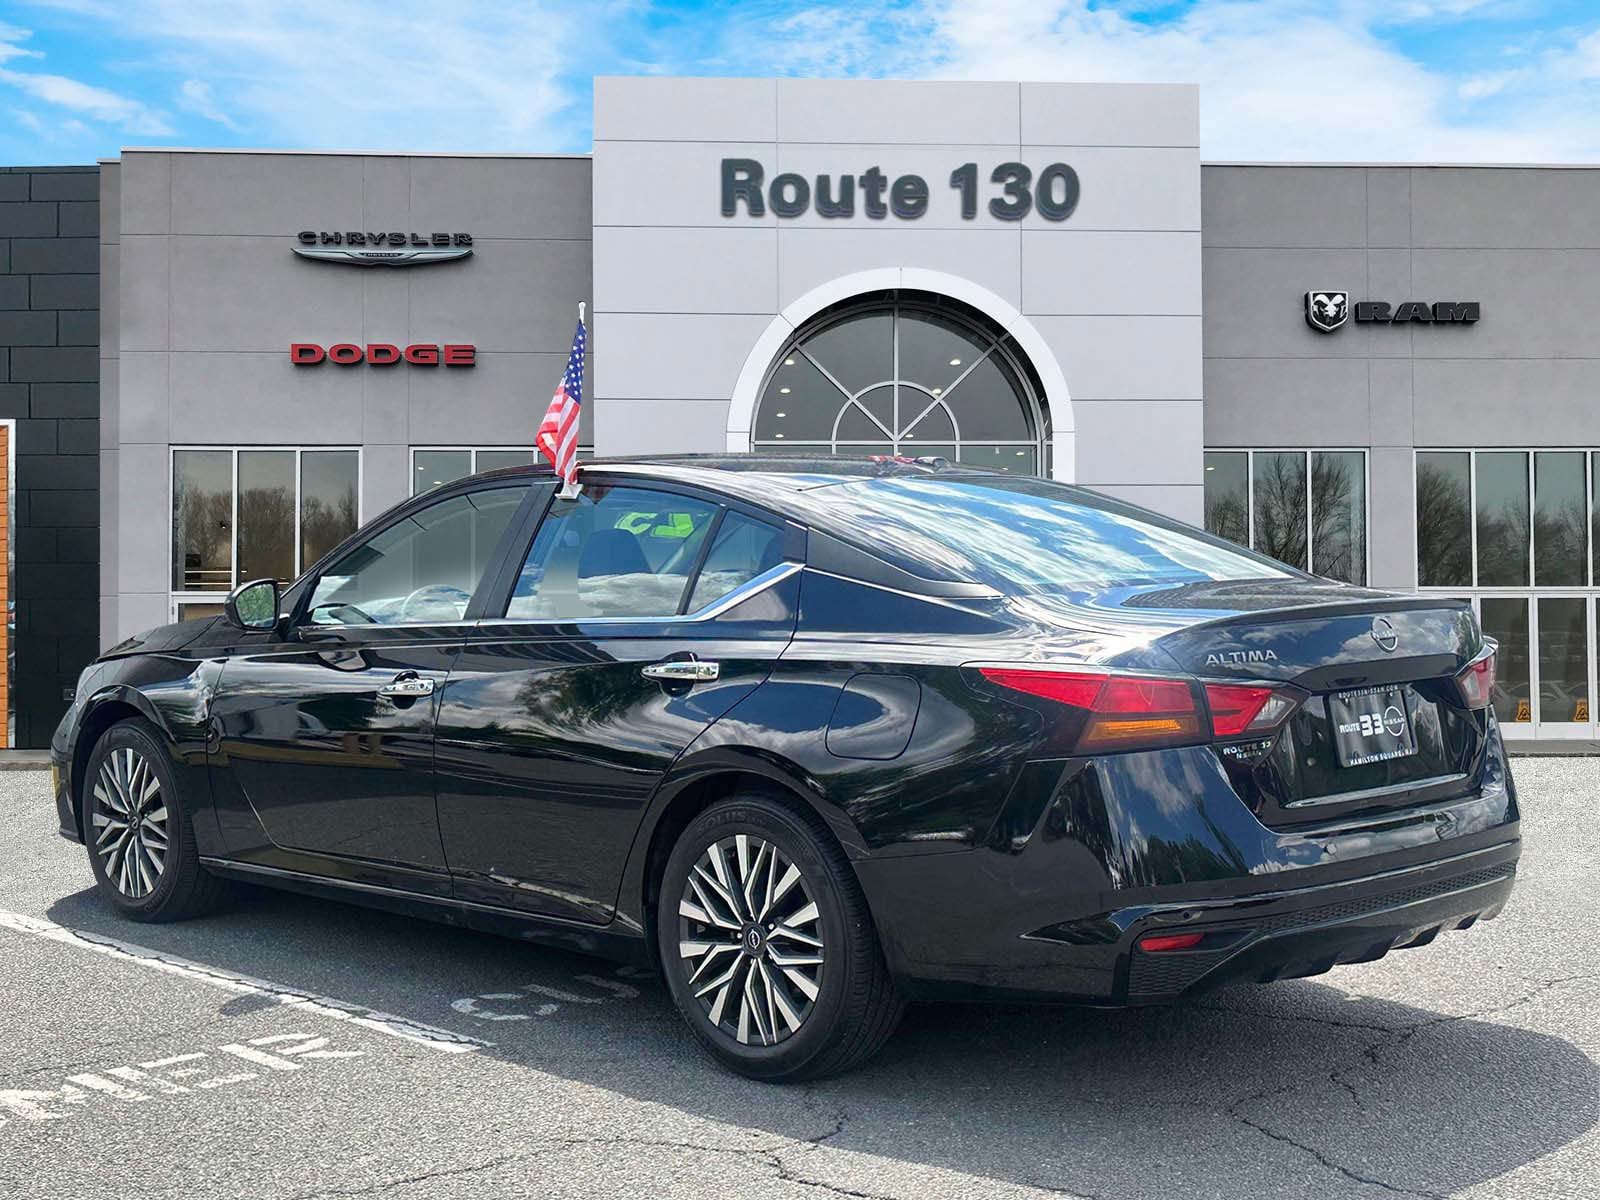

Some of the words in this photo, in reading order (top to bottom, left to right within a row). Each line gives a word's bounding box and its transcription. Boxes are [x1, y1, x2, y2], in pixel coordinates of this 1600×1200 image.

[720, 157, 930, 220] Route
[949, 161, 1081, 222] 130
[298, 231, 473, 246] CHRYSLER
[1355, 301, 1481, 324] RAM
[291, 343, 477, 367] DODGE
[1205, 649, 1278, 667] ALTIMA
[1339, 722, 1361, 734] ROUTE
[1359, 712, 1385, 737] 33
[1350, 754, 1379, 766] HAMILTON
